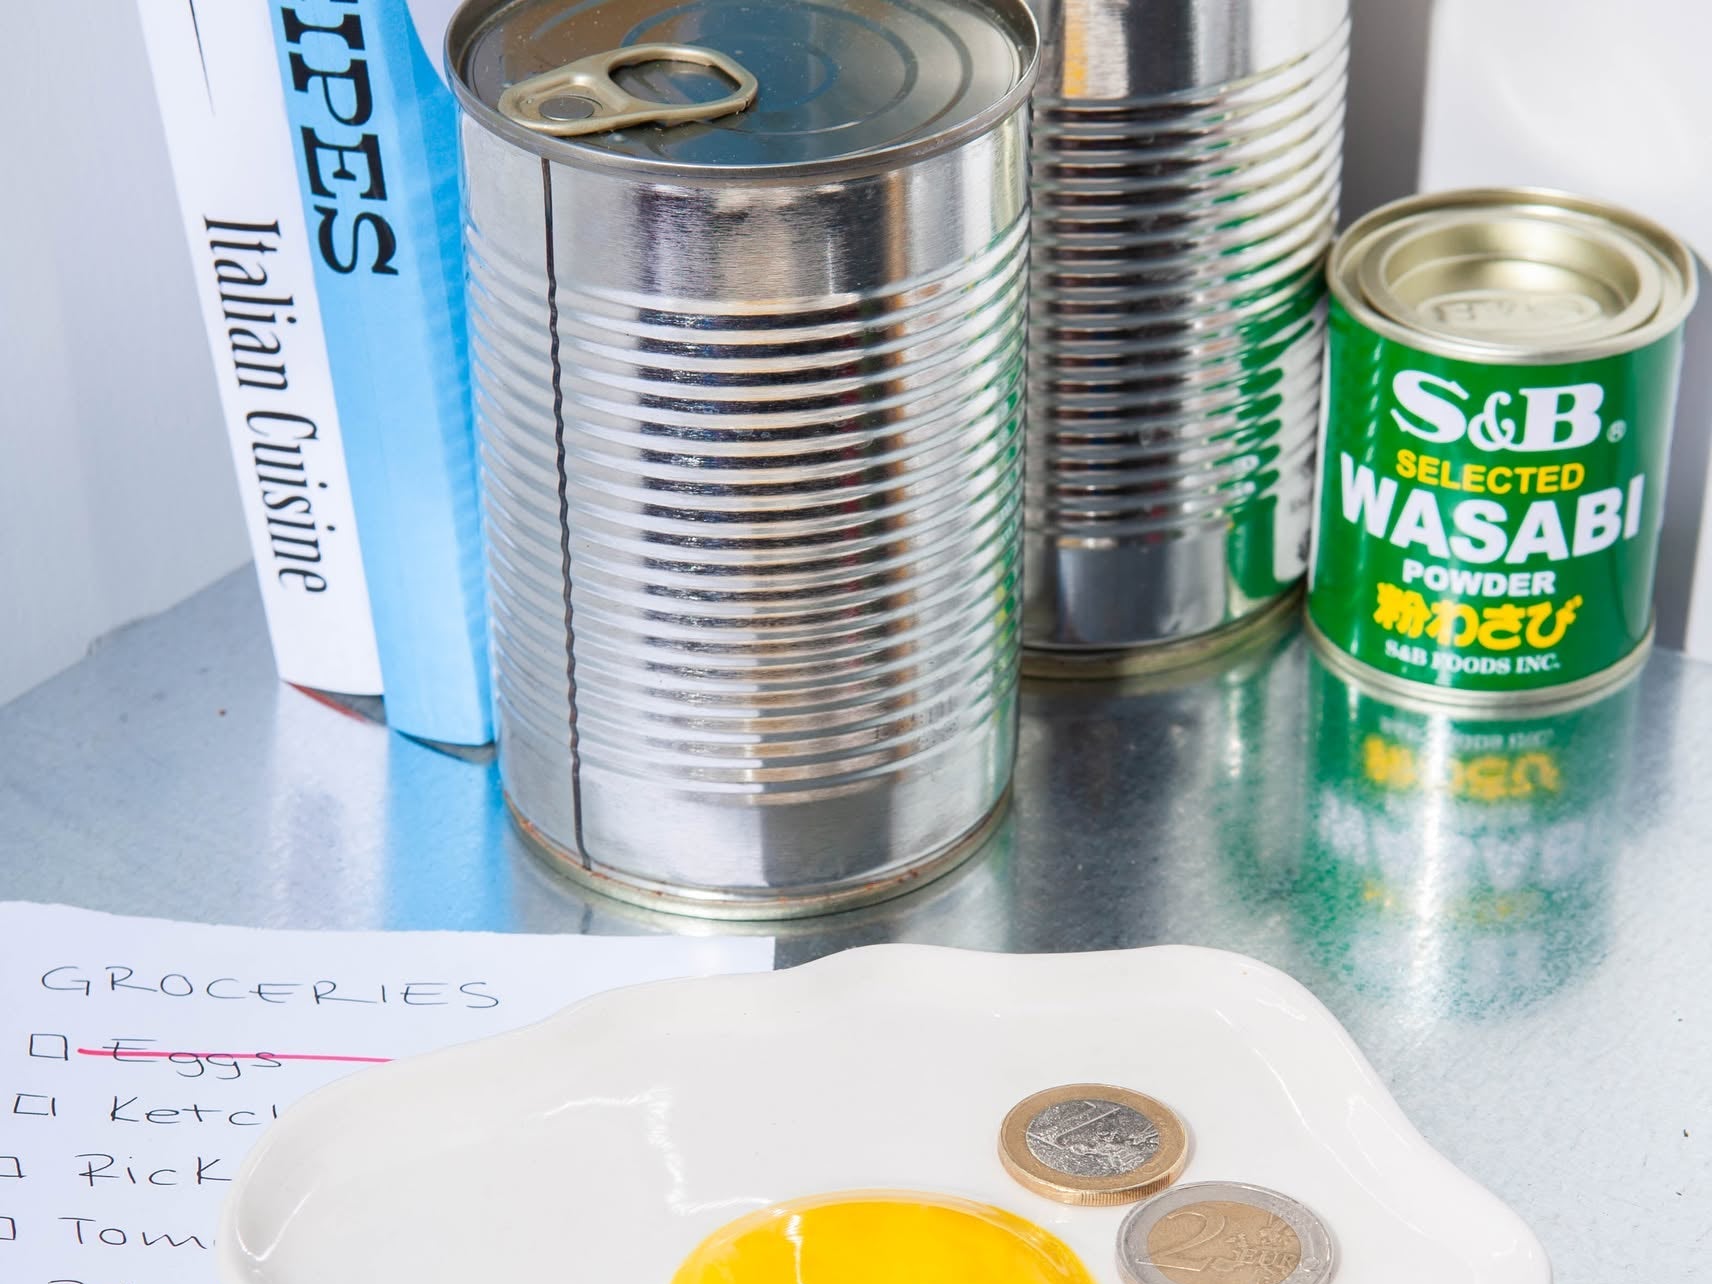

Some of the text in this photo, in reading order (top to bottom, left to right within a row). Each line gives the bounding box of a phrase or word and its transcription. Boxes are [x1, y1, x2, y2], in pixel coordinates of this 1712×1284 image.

[281, 0, 399, 276] IPES
[204, 214, 336, 593] Italian Cuisine
[1396, 448, 1585, 495] SELECTED
[1340, 450, 1646, 567] WASABI
[1402, 559, 1557, 598] POWDER
[1385, 640, 1561, 675] S&B FOODS INC.
[41, 966, 499, 1008] GROCERIES
[103, 1038, 282, 1079] Eggs
[110, 1095, 279, 1126] Ketc
[58, 1216, 216, 1250] Tom
[1136, 1209, 1227, 1272] 2
